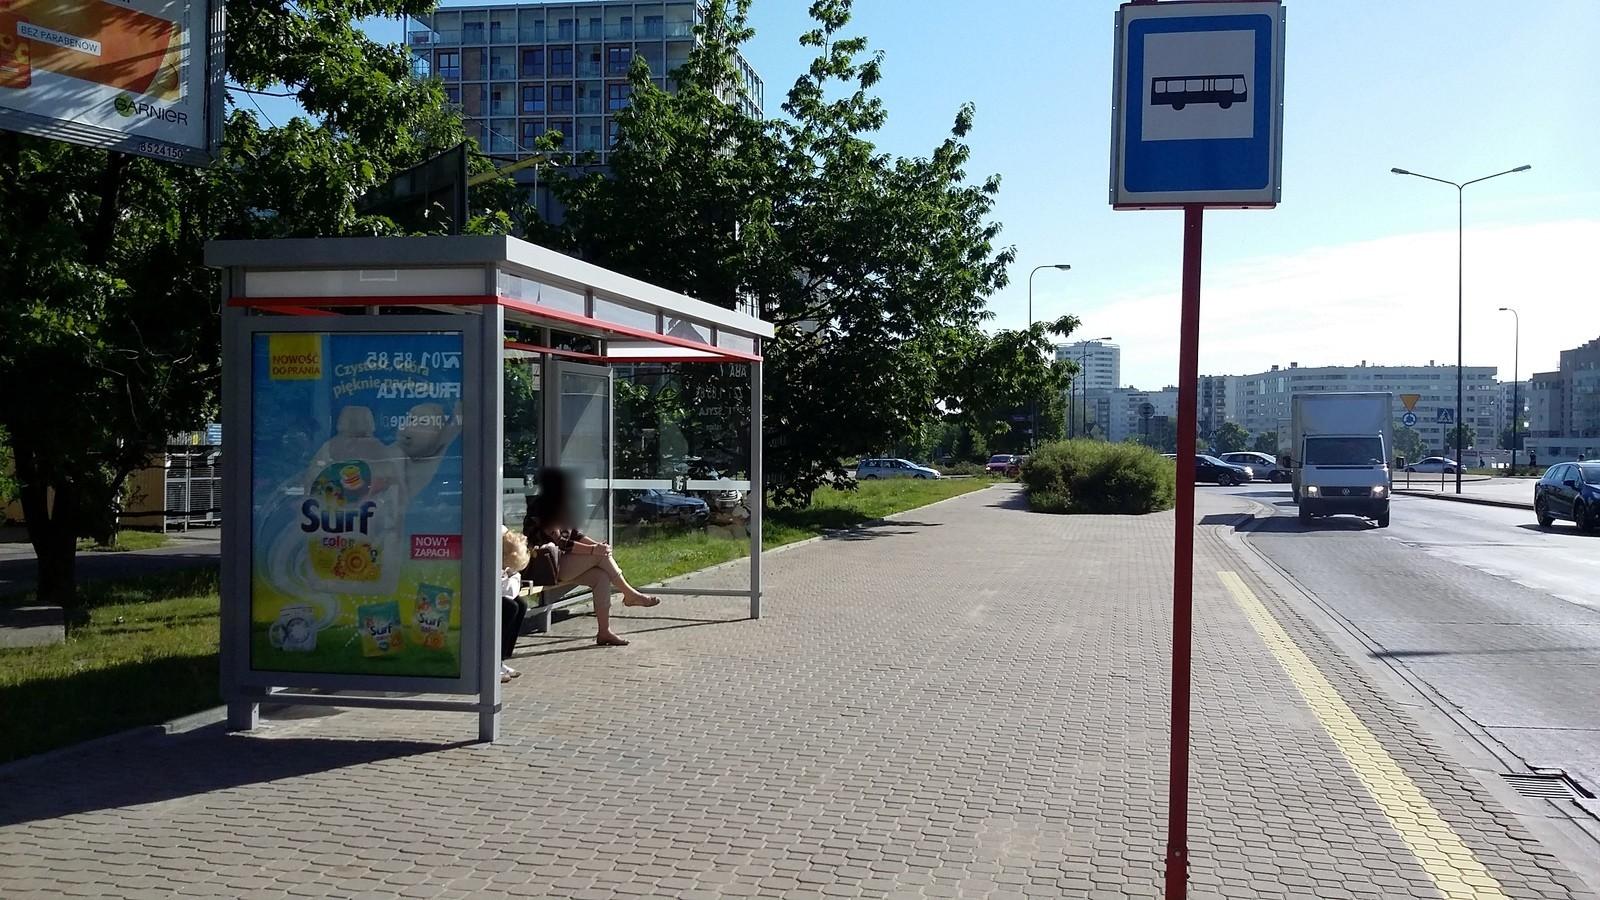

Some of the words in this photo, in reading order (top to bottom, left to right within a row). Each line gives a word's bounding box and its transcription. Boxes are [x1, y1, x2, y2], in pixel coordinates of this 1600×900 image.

[20, 25, 38, 39] BEZ
[272, 366, 287, 375] DO
[288, 366, 320, 375] PRANIA
[333, 374, 380, 399] pięknie
[301, 498, 377, 535] Surf
[415, 537, 449, 547] NOWY
[414, 548, 450, 558] ZAPACH
[417, 613, 443, 628] Surf
[370, 622, 393, 636] Surf
